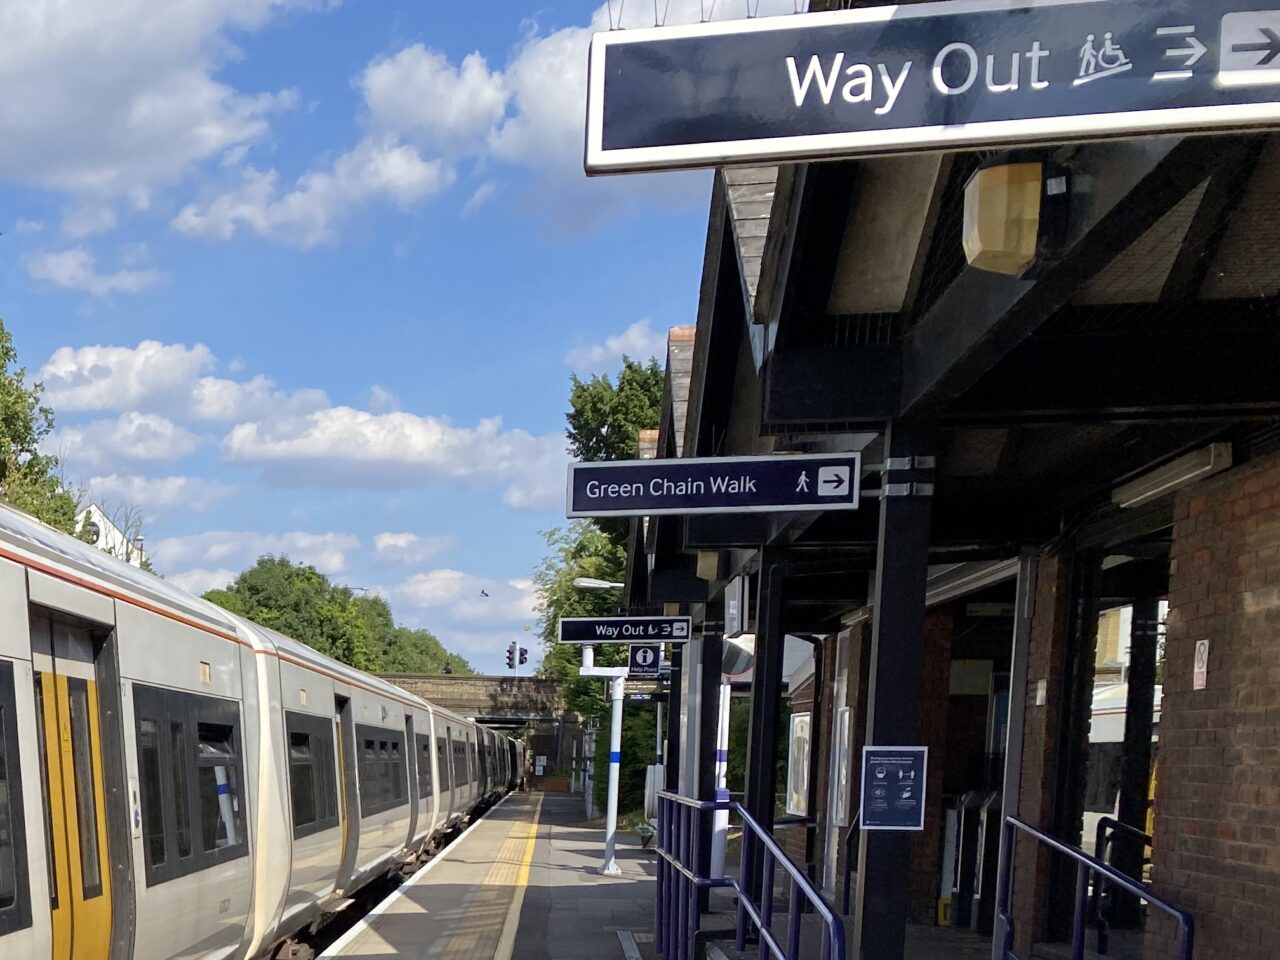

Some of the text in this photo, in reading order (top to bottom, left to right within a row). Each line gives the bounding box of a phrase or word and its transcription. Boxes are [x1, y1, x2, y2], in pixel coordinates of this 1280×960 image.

[786, 40, 1050, 114] Way Out
[586, 476, 757, 498] Green Chain Walk
[595, 624, 644, 638] Way Out
